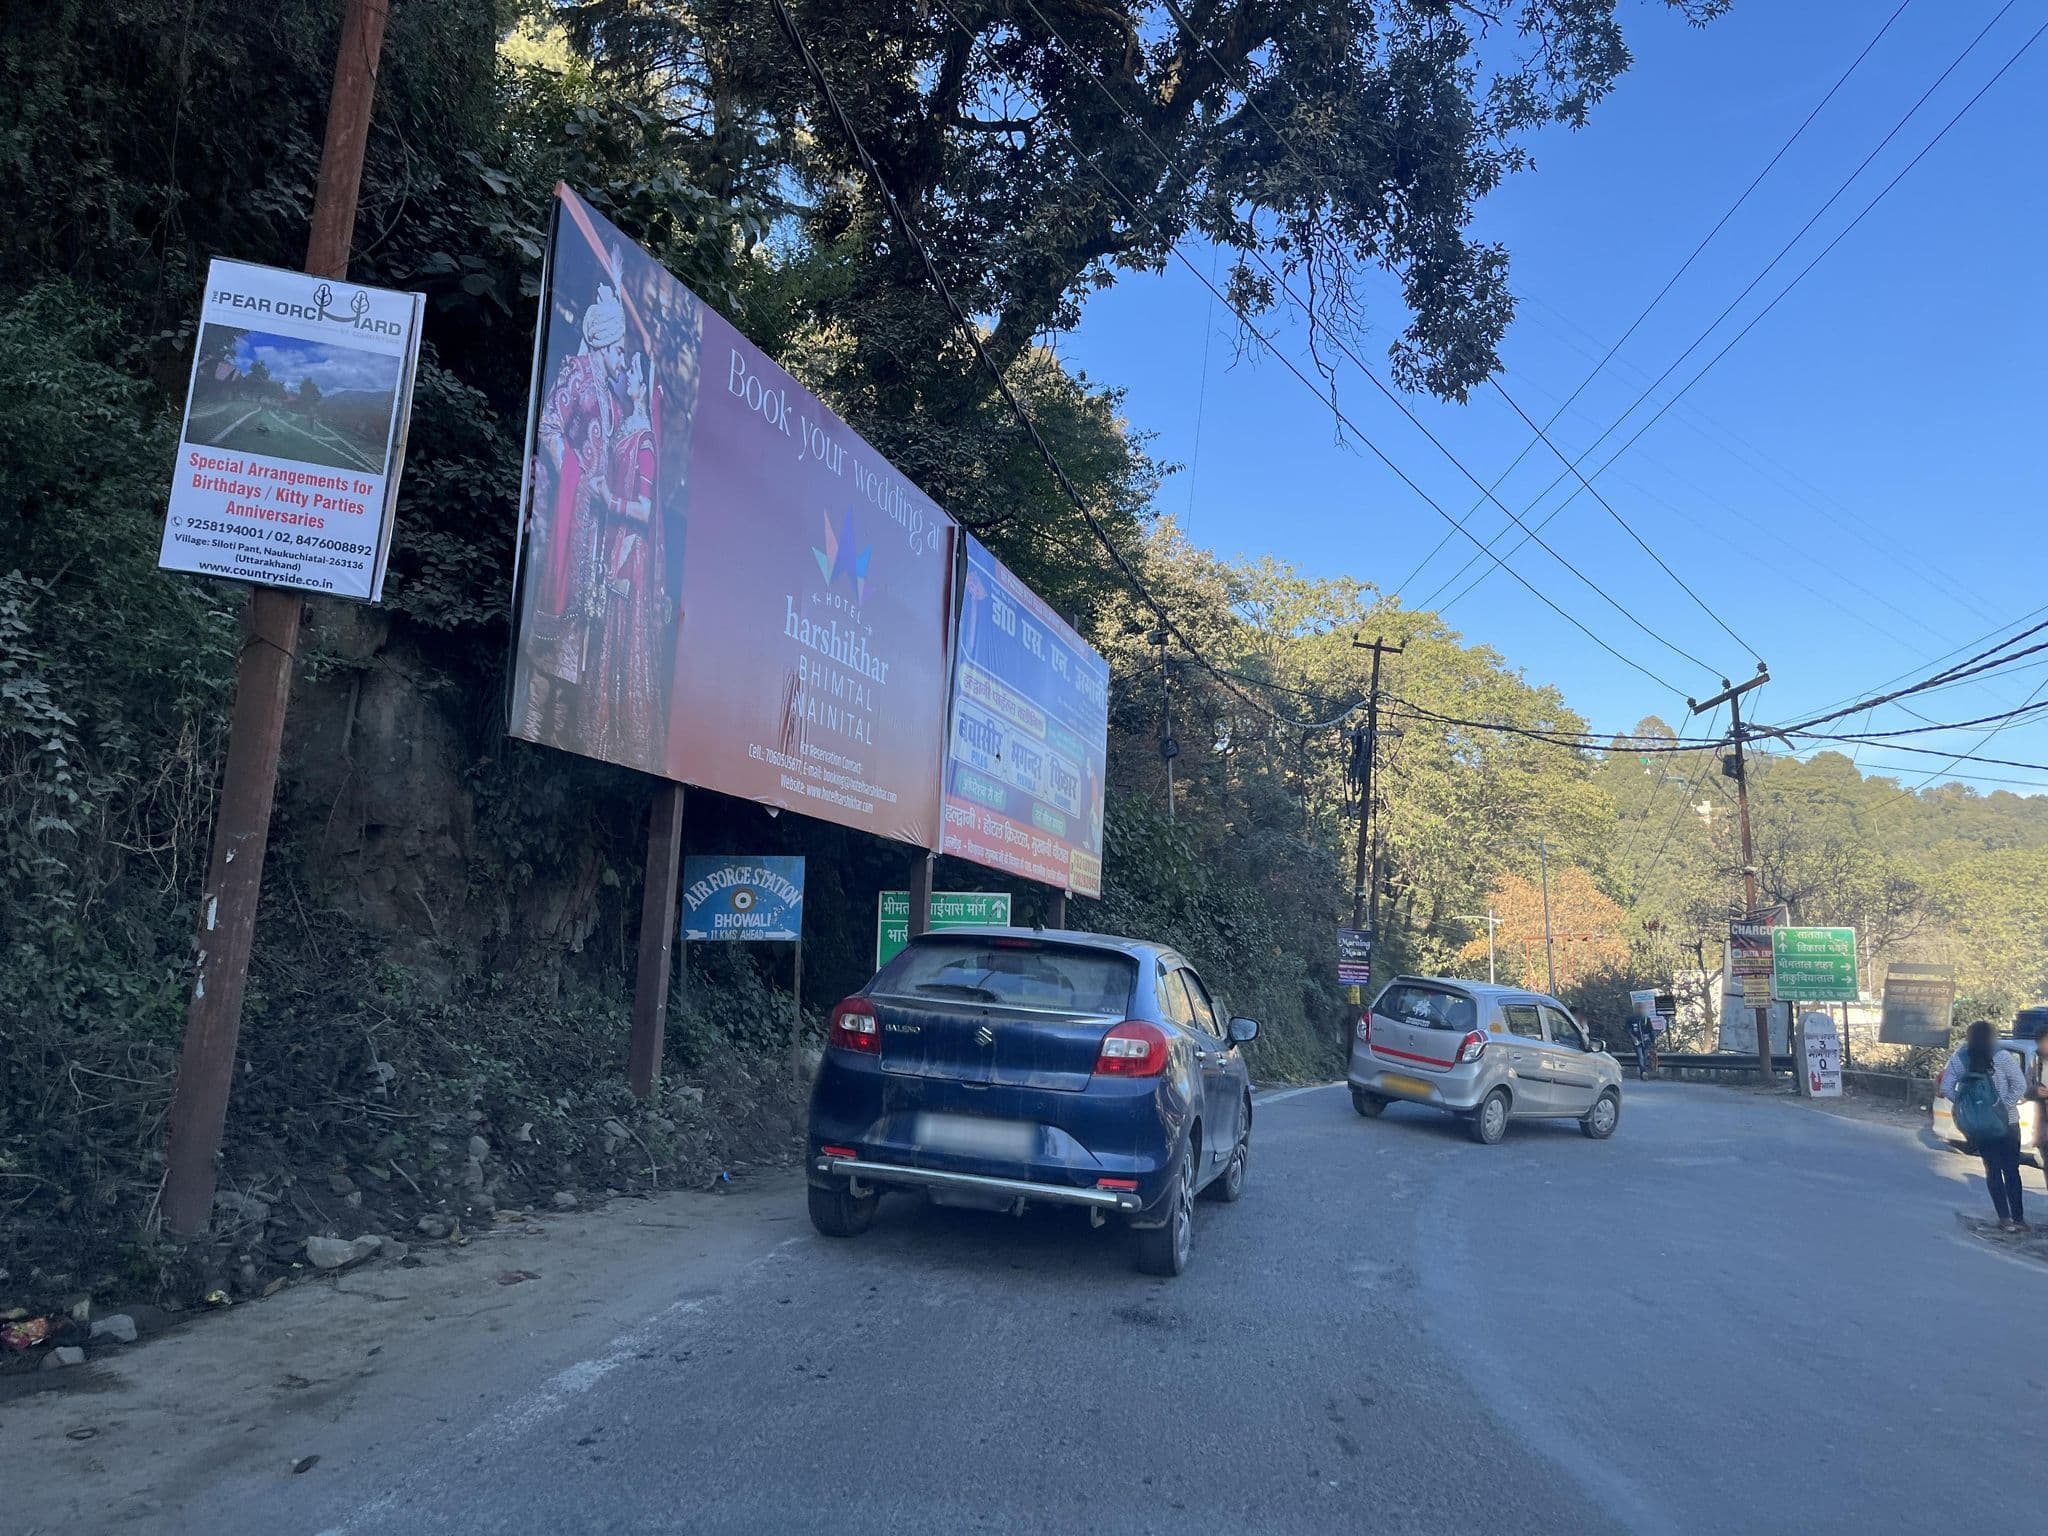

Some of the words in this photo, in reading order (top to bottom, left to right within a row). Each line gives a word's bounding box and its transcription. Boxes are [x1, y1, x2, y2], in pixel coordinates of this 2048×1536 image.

[218, 291, 271, 313] PEAR
[728, 348, 792, 437] Book
[798, 415, 848, 477] your
[853, 459, 923, 555] wedding
[927, 522, 940, 552] at
[189, 452, 244, 474] Special
[247, 462, 349, 491] Arrangements
[353, 480, 373, 495] for
[192, 473, 261, 499] Birthdays
[265, 485, 272, 500] /
[276, 487, 309, 508] Kitty
[313, 494, 365, 515] Parties
[225, 500, 325, 529] Anniversaries
[174, 533, 210, 547] Village:
[211, 539, 236, 550] Siloti
[238, 543, 262, 555] Pant,
[187, 517, 264, 540] 9258194001
[275, 531, 293, 545] 02,
[296, 535, 372, 556] 8476008892
[199, 561, 334, 589] www.countryside.co.in
[235, 555, 301, 572] (Uttarakhand)
[826, 592, 861, 625] HOTEL
[784, 594, 888, 685] harshikhar
[799, 654, 873, 712] BHIMTAL
[793, 690, 873, 745] NAINITAL
[684, 880, 713, 912] AIR
[706, 866, 752, 892] FORCE
[752, 868, 803, 909] STATION
[715, 913, 771, 928] BHOWALI
[966, 898, 986, 917] मार्ग
[720, 930, 738, 940] KMS
[740, 929, 764, 940] AHEAD
[885, 1023, 921, 1034] BALENO
